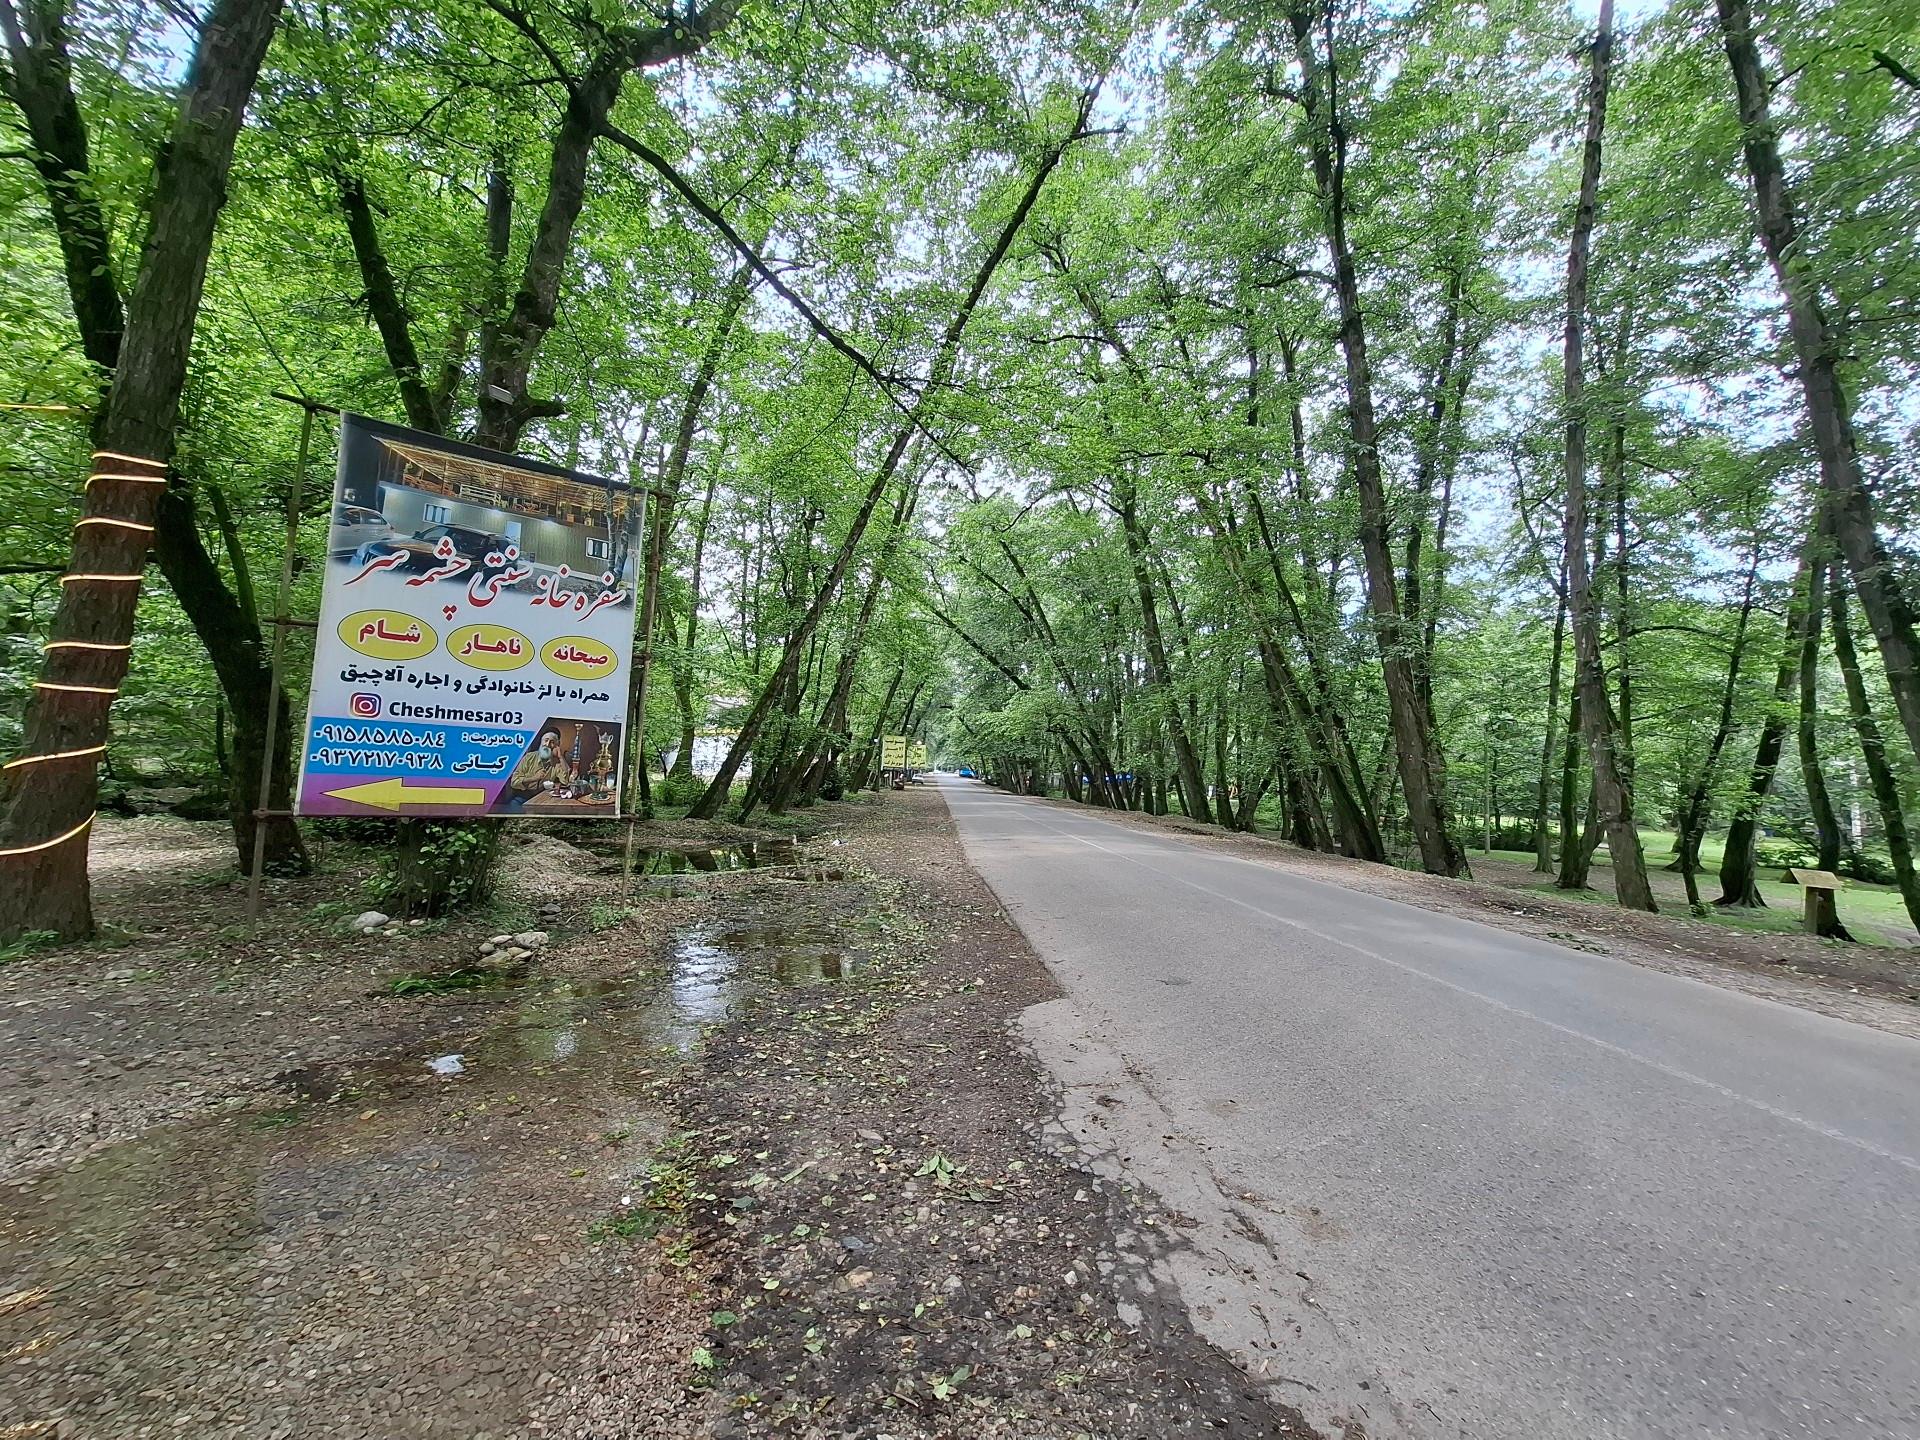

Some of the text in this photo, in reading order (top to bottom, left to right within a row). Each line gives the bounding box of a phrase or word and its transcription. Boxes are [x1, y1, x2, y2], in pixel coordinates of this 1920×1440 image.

[342, 539, 627, 623] سفره خانه سنتی چشمه سر
[358, 618, 422, 644] شام
[460, 633, 522, 656] ناهار
[552, 645, 609, 668] صبحانه
[339, 663, 611, 703] همراه با لژ خانوادگی و اجاره آلاچیق
[388, 701, 524, 726] Cheshmesar03
[515, 733, 525, 748] با
[452, 753, 508, 774] کیانی
